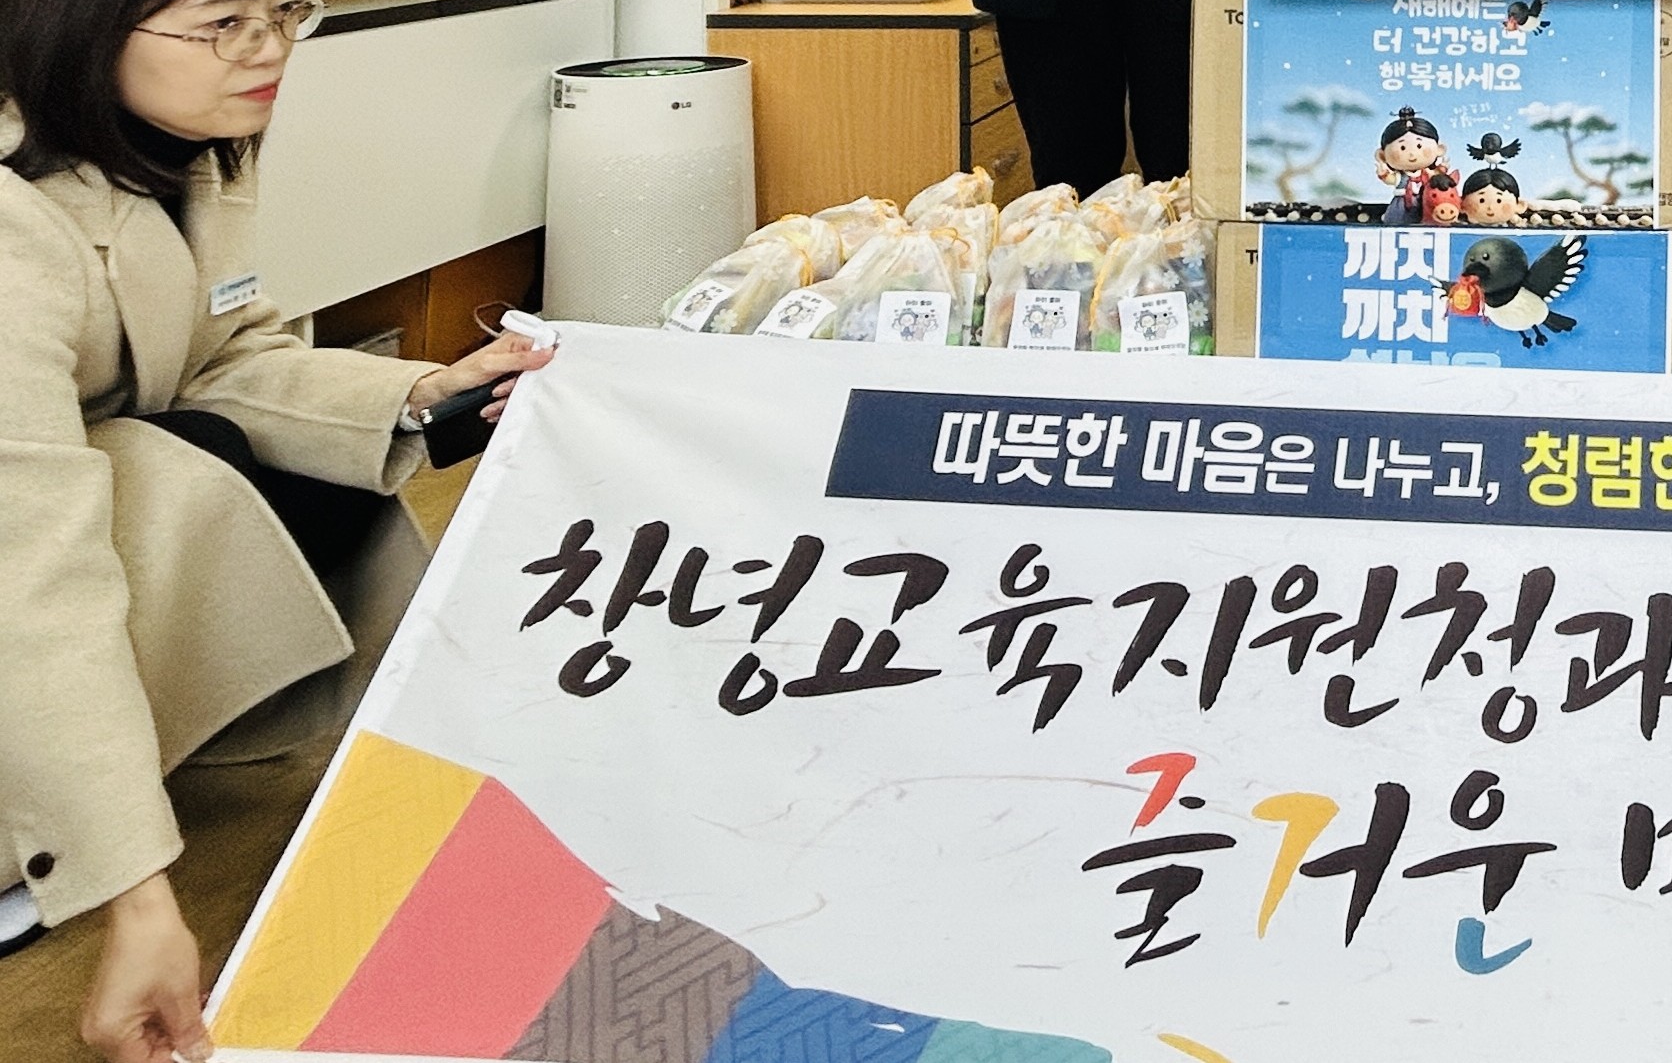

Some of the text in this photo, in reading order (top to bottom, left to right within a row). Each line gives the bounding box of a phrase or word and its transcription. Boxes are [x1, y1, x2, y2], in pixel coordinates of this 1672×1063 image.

[1372, 24, 1529, 56] 더 건강하고
[1378, 60, 1523, 92] 행복하세요
[1343, 228, 1451, 282] 까치
[1341, 288, 1450, 343] 까치
[930, 410, 1128, 488] 따뜻한
[1140, 419, 1316, 495] 마음은
[1332, 436, 1500, 506] 나누고,
[1081, 751, 1558, 975] 즐거운
